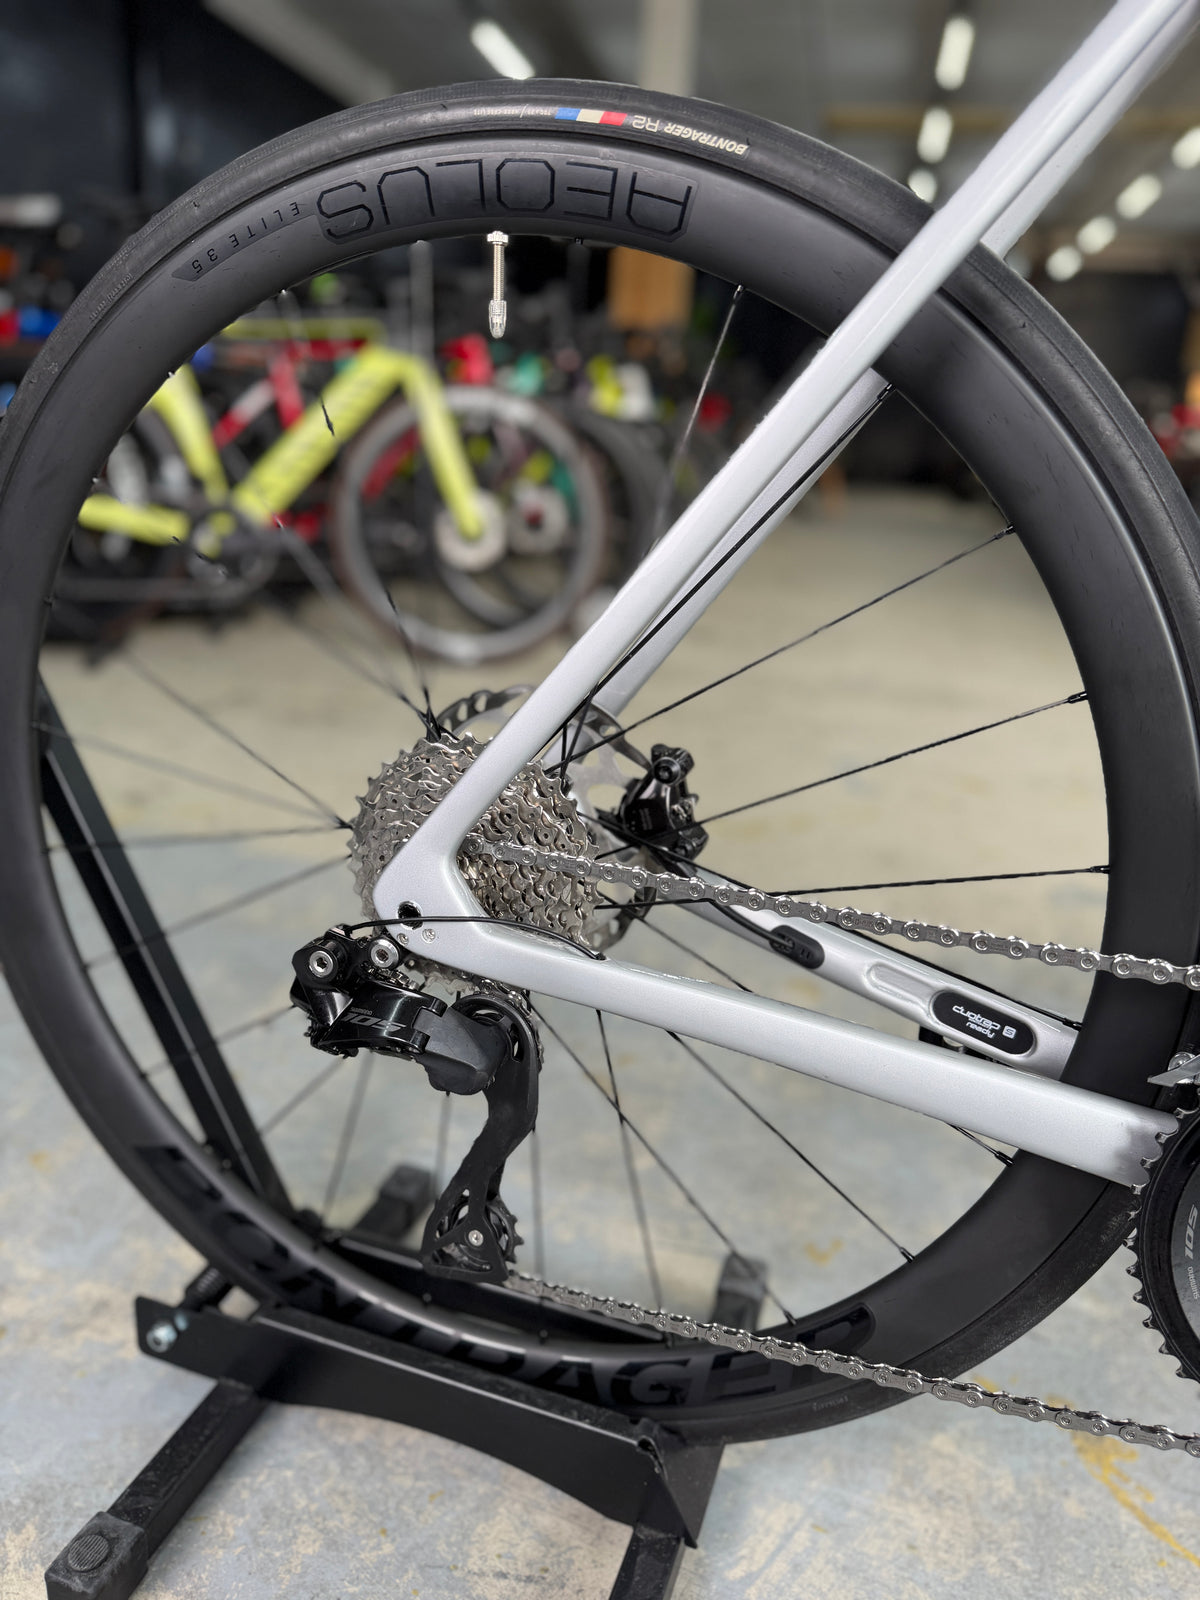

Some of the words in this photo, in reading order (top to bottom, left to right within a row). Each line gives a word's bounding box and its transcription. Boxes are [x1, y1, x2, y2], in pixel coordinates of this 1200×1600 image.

[632, 115, 660, 133] R2
[664, 121, 749, 156] BONTRAGER
[316, 158, 692, 240] AEOLUS
[229, 201, 300, 248] ELITE
[191, 248, 218, 273] 35
[340, 1012, 407, 1032] 105
[952, 1005, 1001, 1030] duotrap
[966, 1021, 995, 1039] ready
[1185, 1204, 1198, 1260] 105
